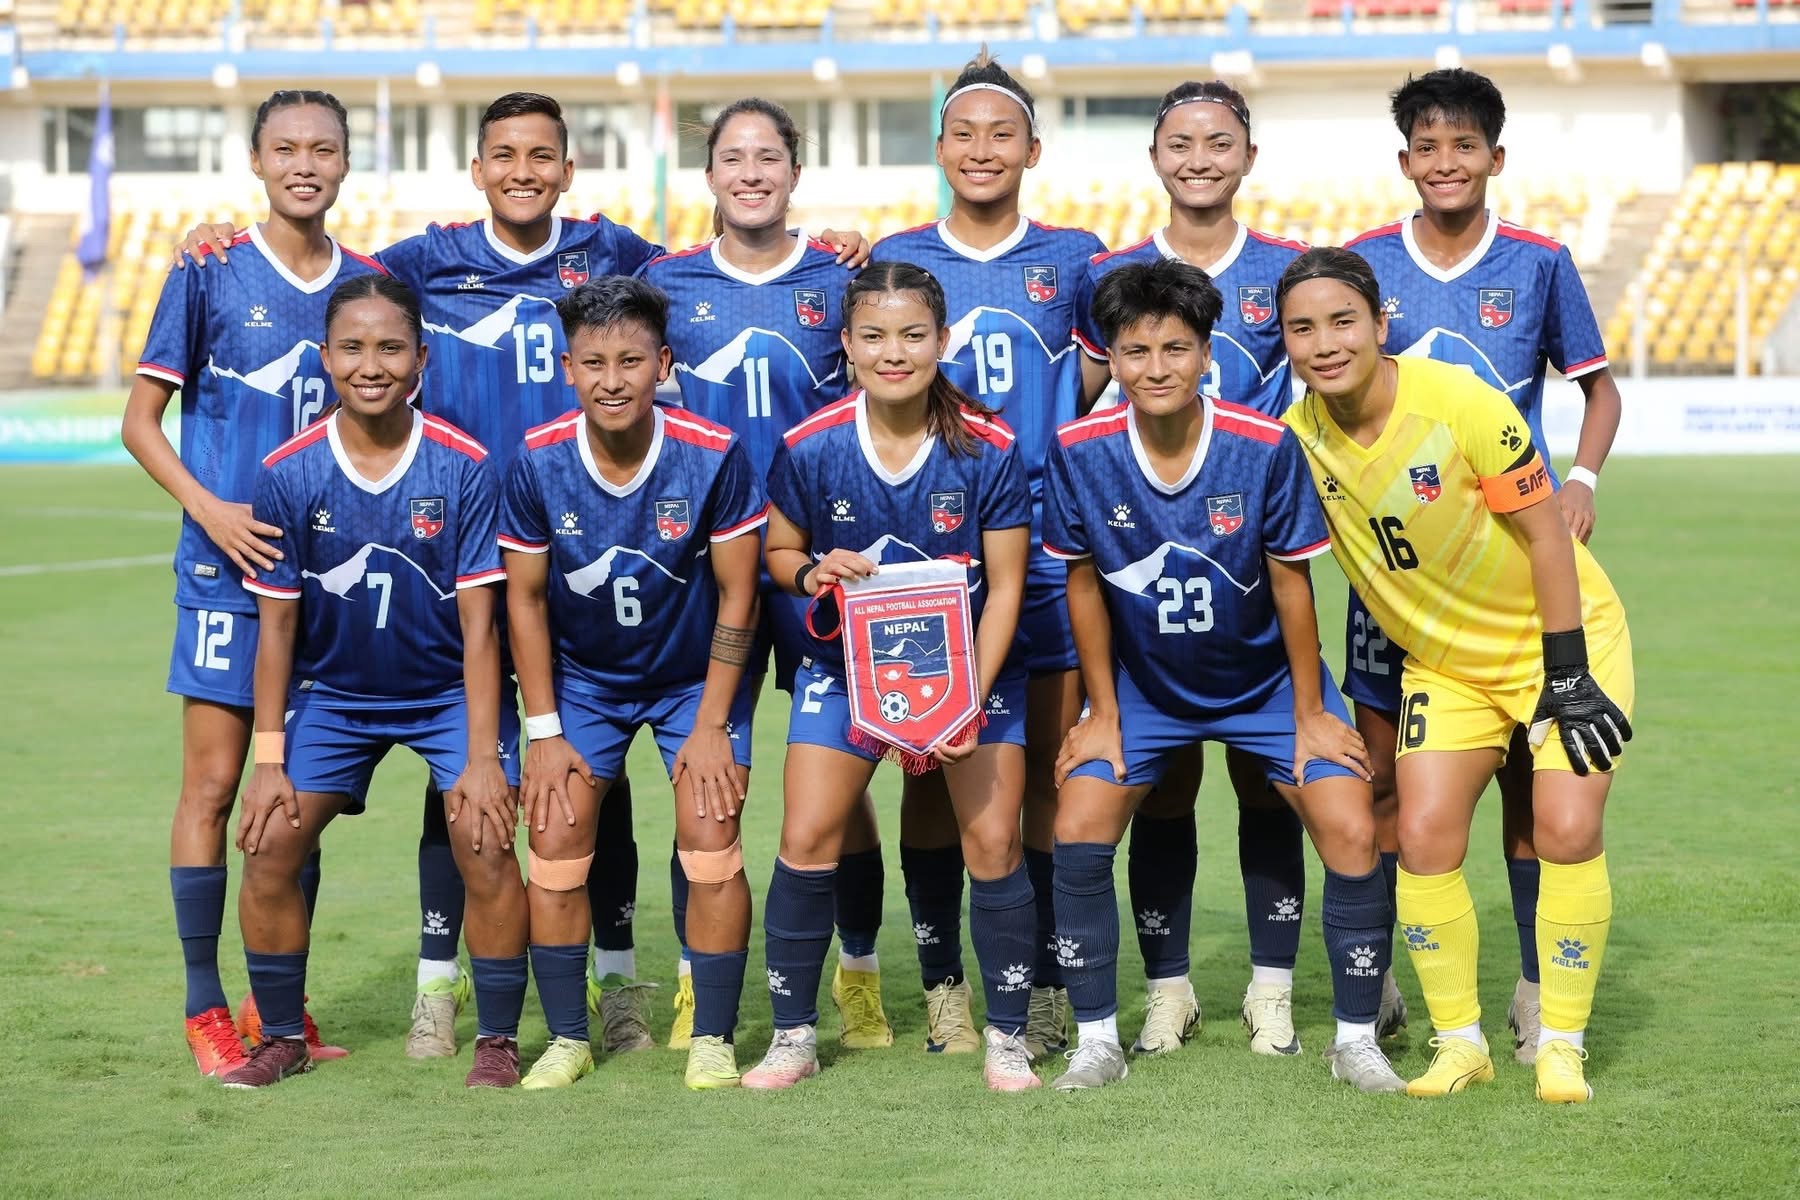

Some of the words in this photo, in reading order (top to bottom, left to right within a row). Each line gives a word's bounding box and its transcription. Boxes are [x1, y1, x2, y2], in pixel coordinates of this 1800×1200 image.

[458, 282, 485, 290] KELME
[690, 314, 716, 322] KELME
[513, 323, 555, 384] 13
[971, 332, 1013, 395] 19
[743, 357, 772, 418] 11
[292, 376, 326, 434] 12
[312, 524, 336, 533] KELME
[555, 528, 584, 536] KELME
[1107, 519, 1136, 529] KELME
[1368, 515, 1420, 572] 16
[366, 573, 393, 629] 7
[613, 576, 643, 627] 6
[854, 607, 867, 616] ALL
[866, 604, 885, 614] NEPAL
[886, 600, 916, 612] FOOTBALL
[917, 597, 957, 609] ASSOCIATION
[1156, 576, 1215, 634] 23
[884, 620, 930, 636] NEPAL
[194, 609, 234, 671] 12
[1352, 610, 1389, 676] 22
[800, 673, 835, 714] 2
[985, 708, 1011, 716] KELME
[1397, 692, 1429, 753] 16
[1268, 912, 1300, 922] KELME
[423, 925, 450, 936] KELME
[1138, 927, 1170, 936] KELME
[1345, 967, 1379, 977] KELME
[1551, 956, 1590, 970] KELME
